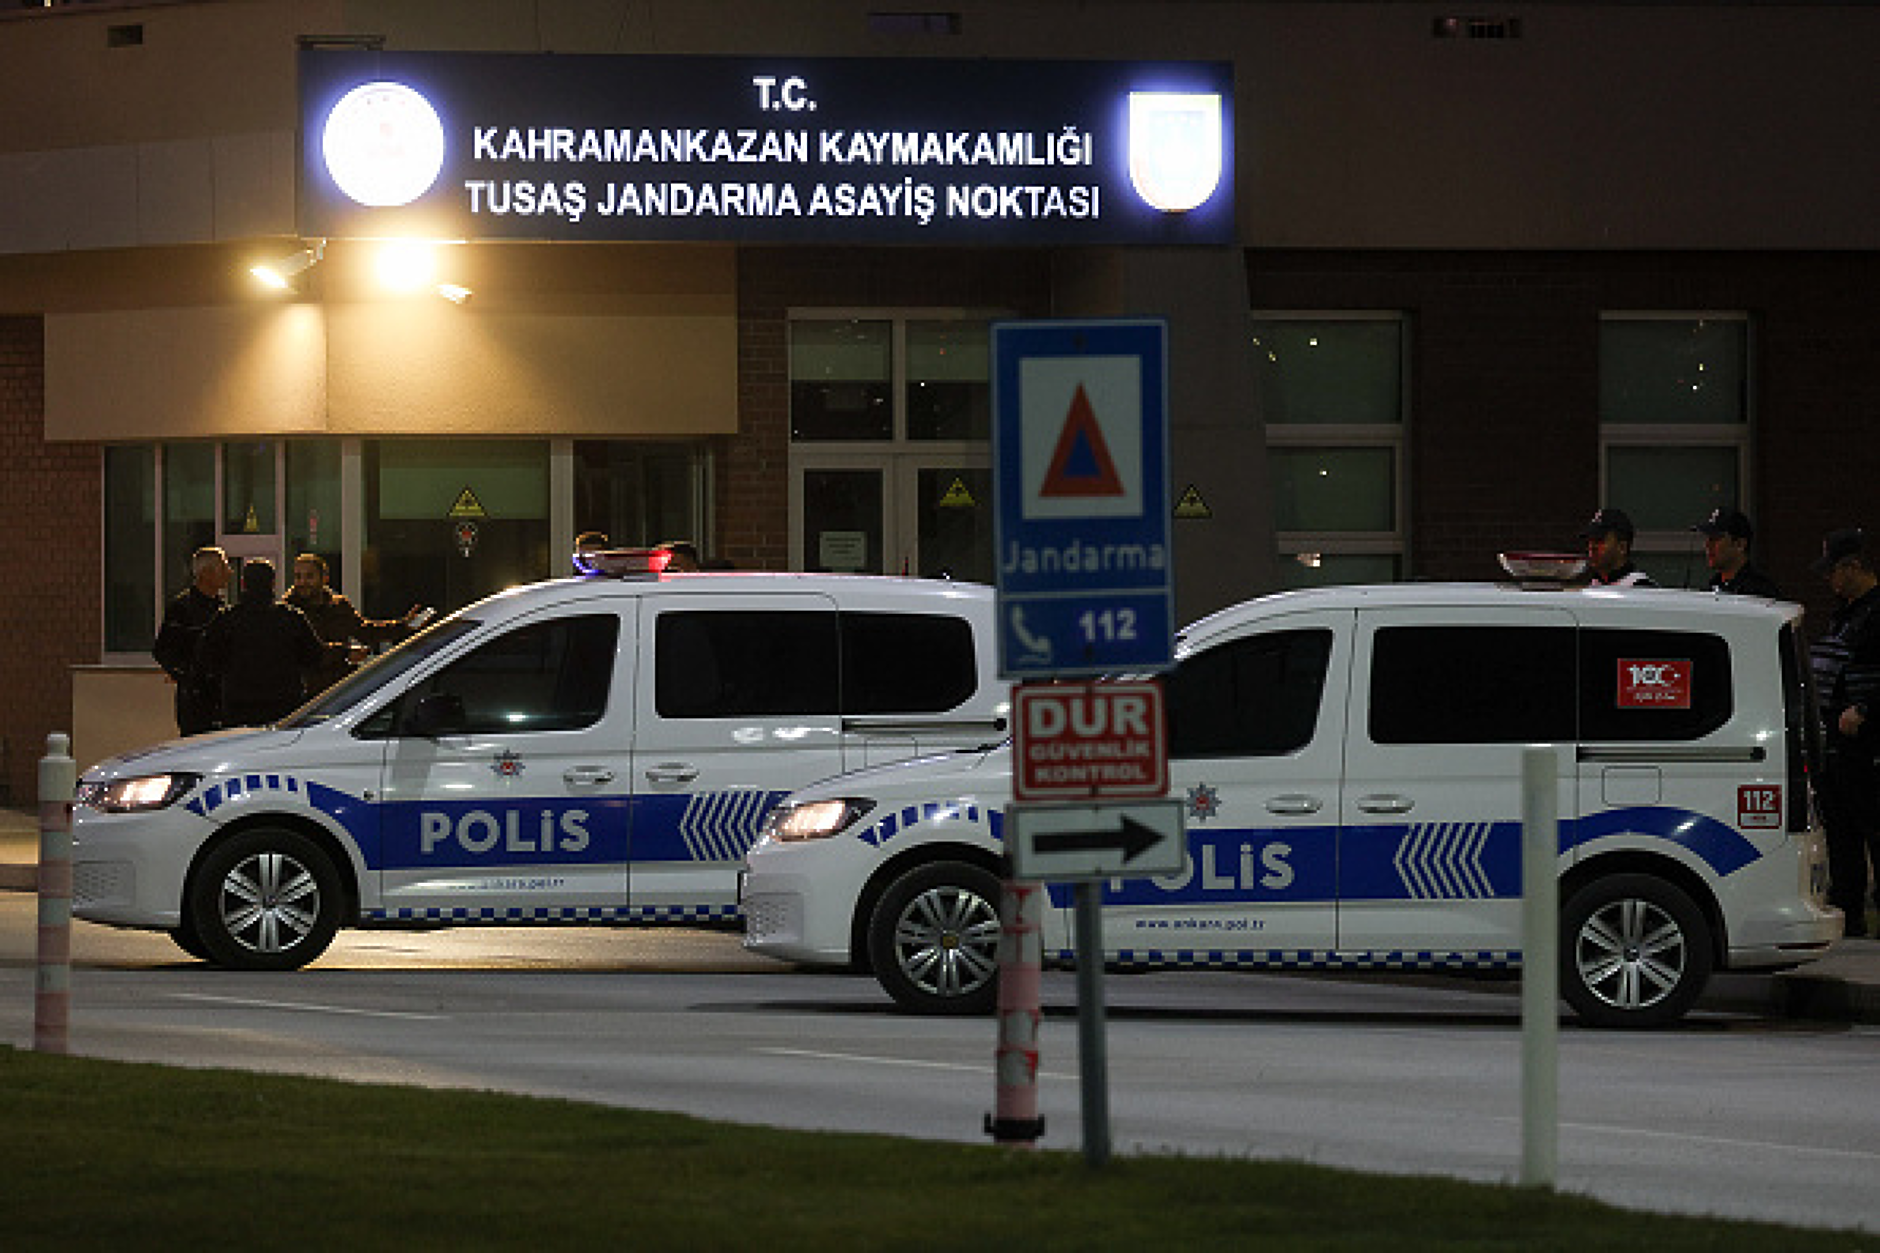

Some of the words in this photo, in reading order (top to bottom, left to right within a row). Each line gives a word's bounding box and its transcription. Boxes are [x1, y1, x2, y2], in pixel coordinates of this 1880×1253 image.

[752, 75, 818, 112] T.C.
[472, 125, 809, 163] KAHRAMANKAZAN
[818, 125, 1094, 167] KAYMAKAMLIĞI
[465, 178, 587, 223] TUSAŞ
[597, 181, 802, 217] JANDARMA
[806, 175, 935, 227] ASAYİŞ
[946, 182, 1100, 219] NOKTASI
[1002, 539, 1166, 574] Jandarma
[1078, 607, 1138, 642] 112
[1027, 695, 1149, 738] DUR
[1034, 763, 1147, 783] KONTROL
[1743, 790, 1775, 811] 112
